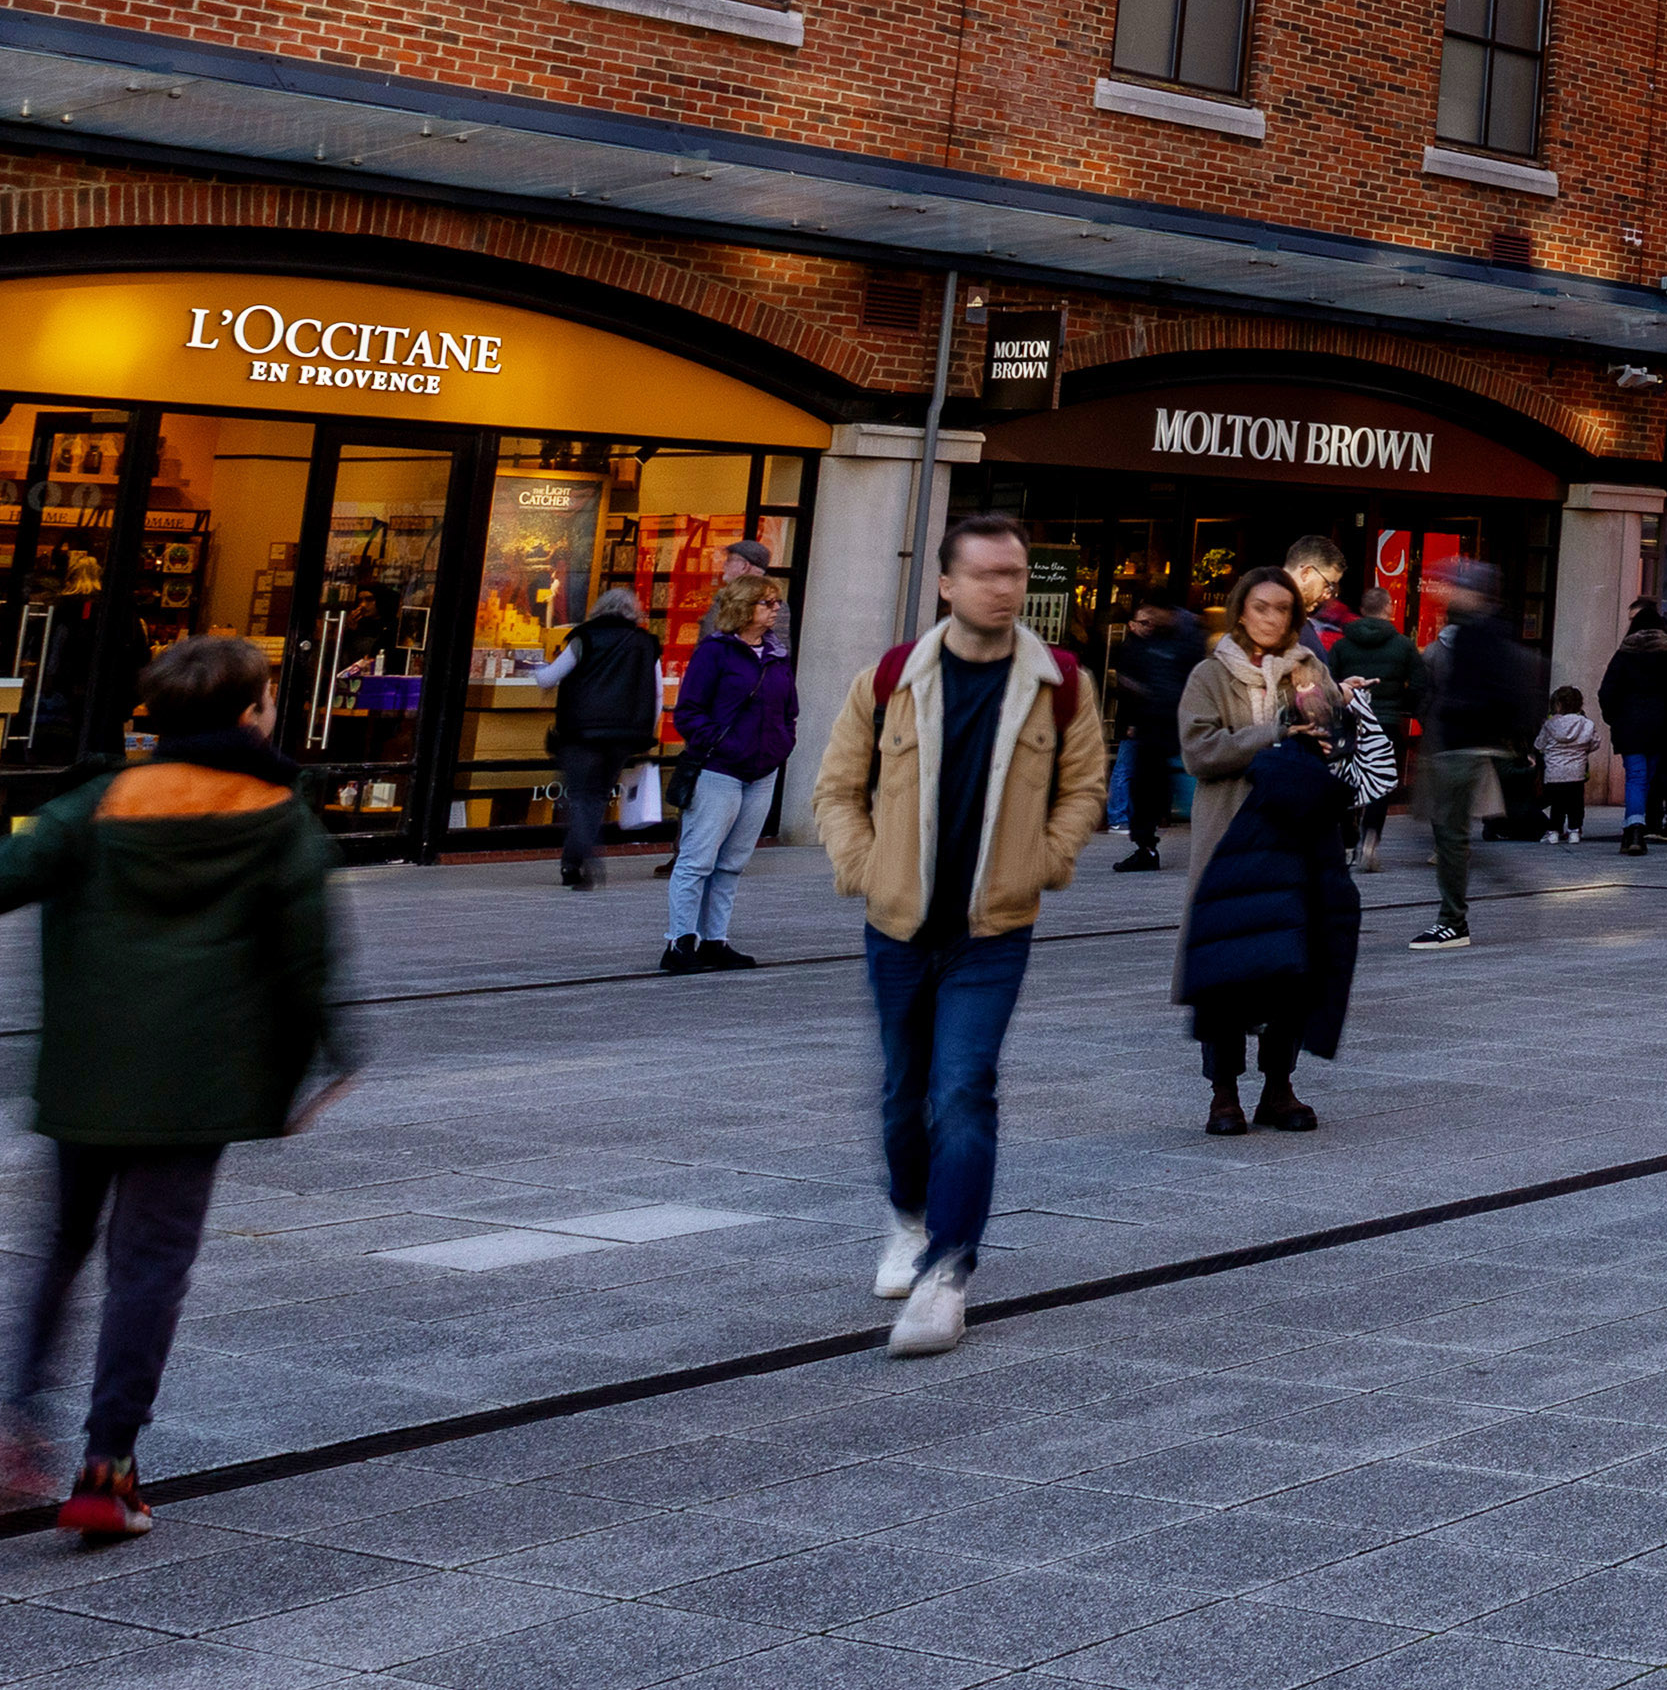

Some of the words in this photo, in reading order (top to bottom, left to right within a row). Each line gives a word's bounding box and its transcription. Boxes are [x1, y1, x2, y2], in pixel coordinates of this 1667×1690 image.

[185, 304, 502, 374] L'OCCITANE
[993, 340, 1050, 358] MOLTON
[250, 361, 290, 382] EN
[298, 365, 441, 395] PROVENCE
[991, 361, 1048, 379] BROWN
[1151, 408, 1300, 462] MOLTON
[1304, 422, 1434, 473] BROWN
[518, 491, 570, 507] CATCHER
